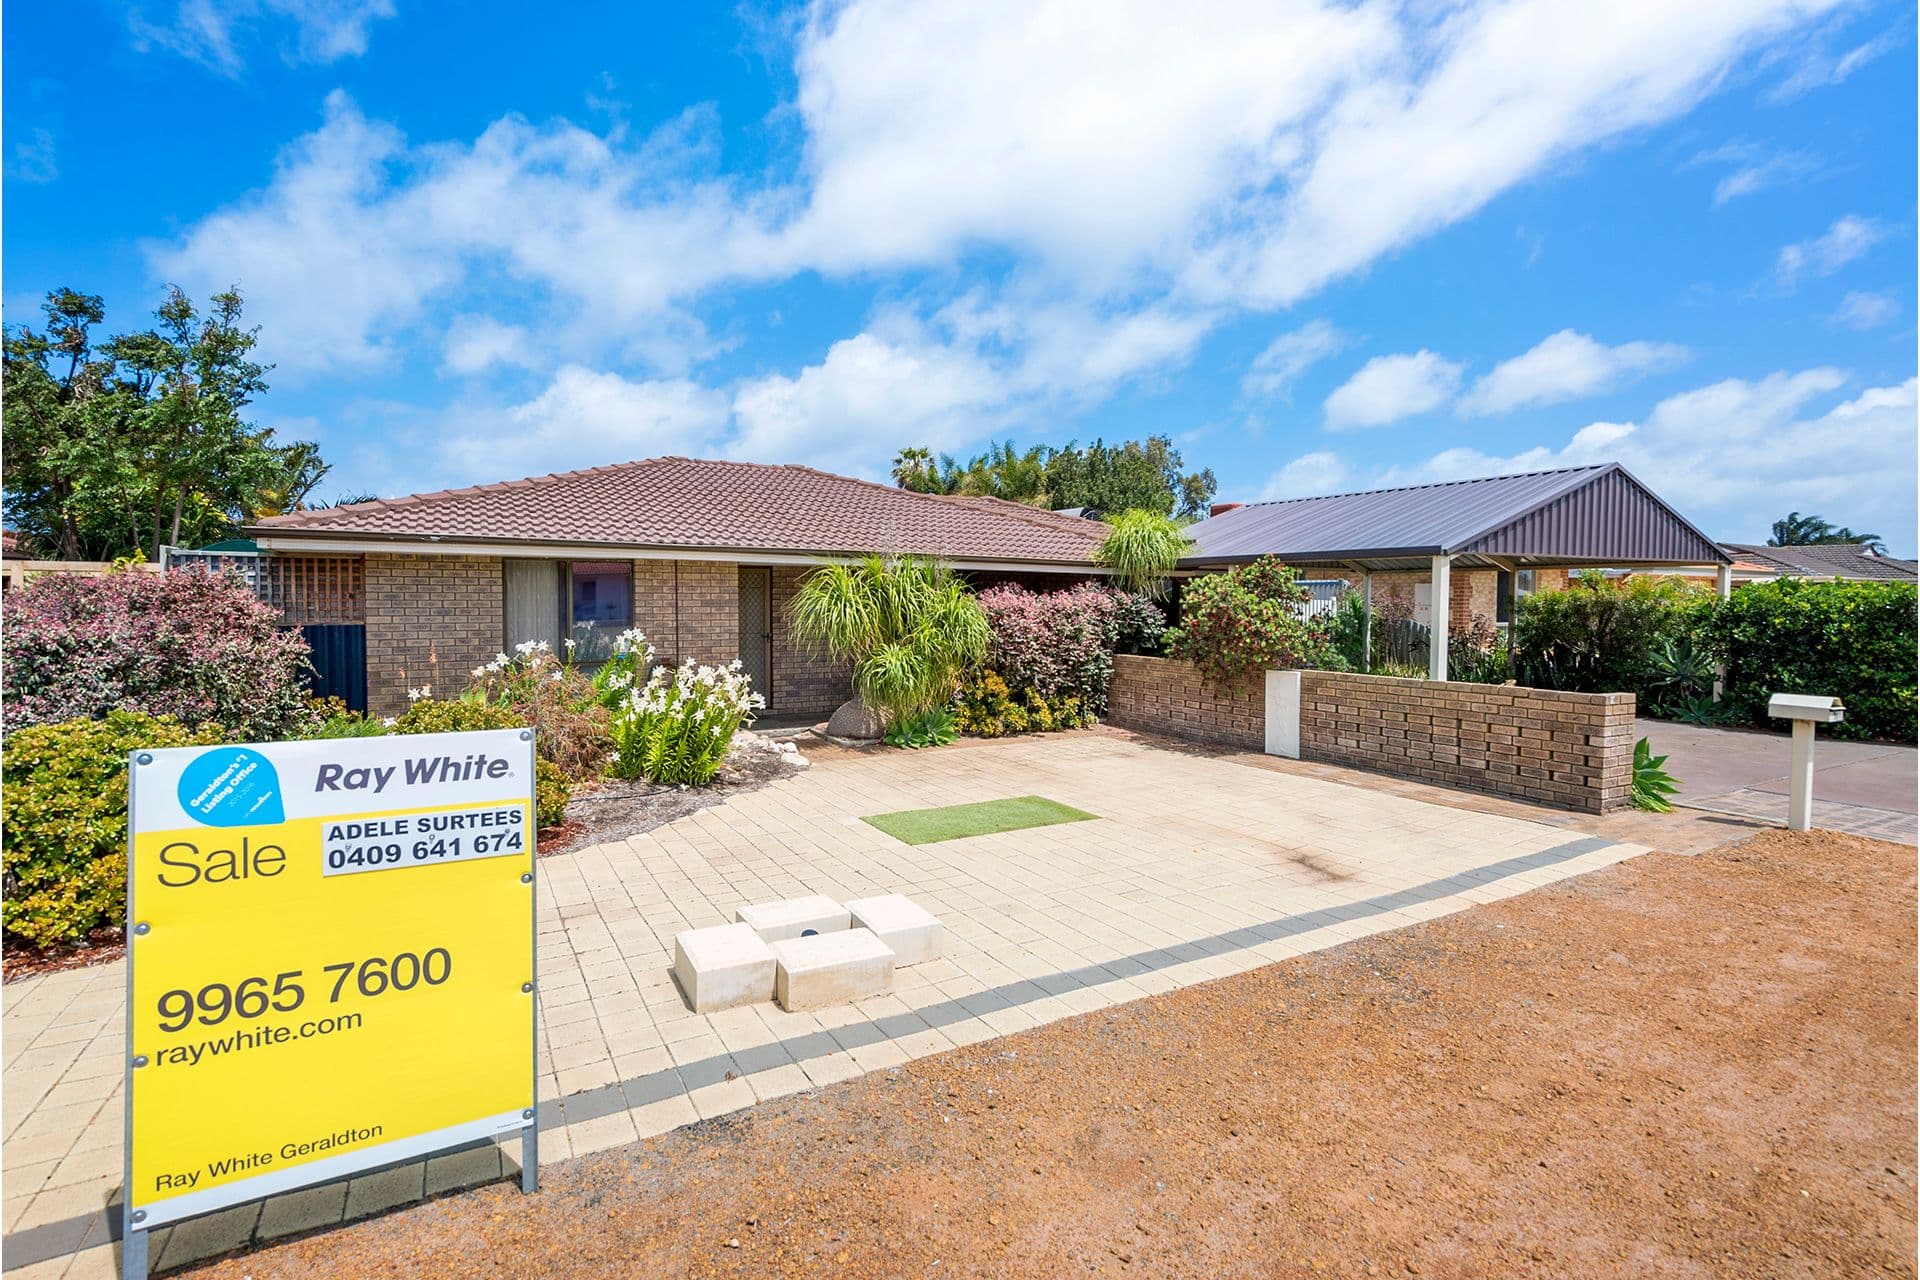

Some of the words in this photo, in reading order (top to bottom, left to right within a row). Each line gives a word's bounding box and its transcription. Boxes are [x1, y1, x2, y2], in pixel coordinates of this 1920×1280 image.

[201, 786, 234, 814] Listing
[230, 762, 258, 786] Office
[315, 763, 396, 794] Ray
[404, 754, 509, 785] White
[327, 819, 409, 842] ADELE
[417, 810, 522, 833] SURTEES
[328, 843, 401, 869] 0409
[412, 837, 461, 860] 641
[473, 832, 522, 854] 674
[157, 836, 287, 888] Sale
[156, 970, 305, 1033] 9965
[323, 947, 451, 1003] 7600
[156, 1013, 362, 1066] raywhite.com
[155, 1170, 201, 1192] Ray
[208, 1152, 273, 1178] White
[280, 1125, 383, 1160] Geraldton
